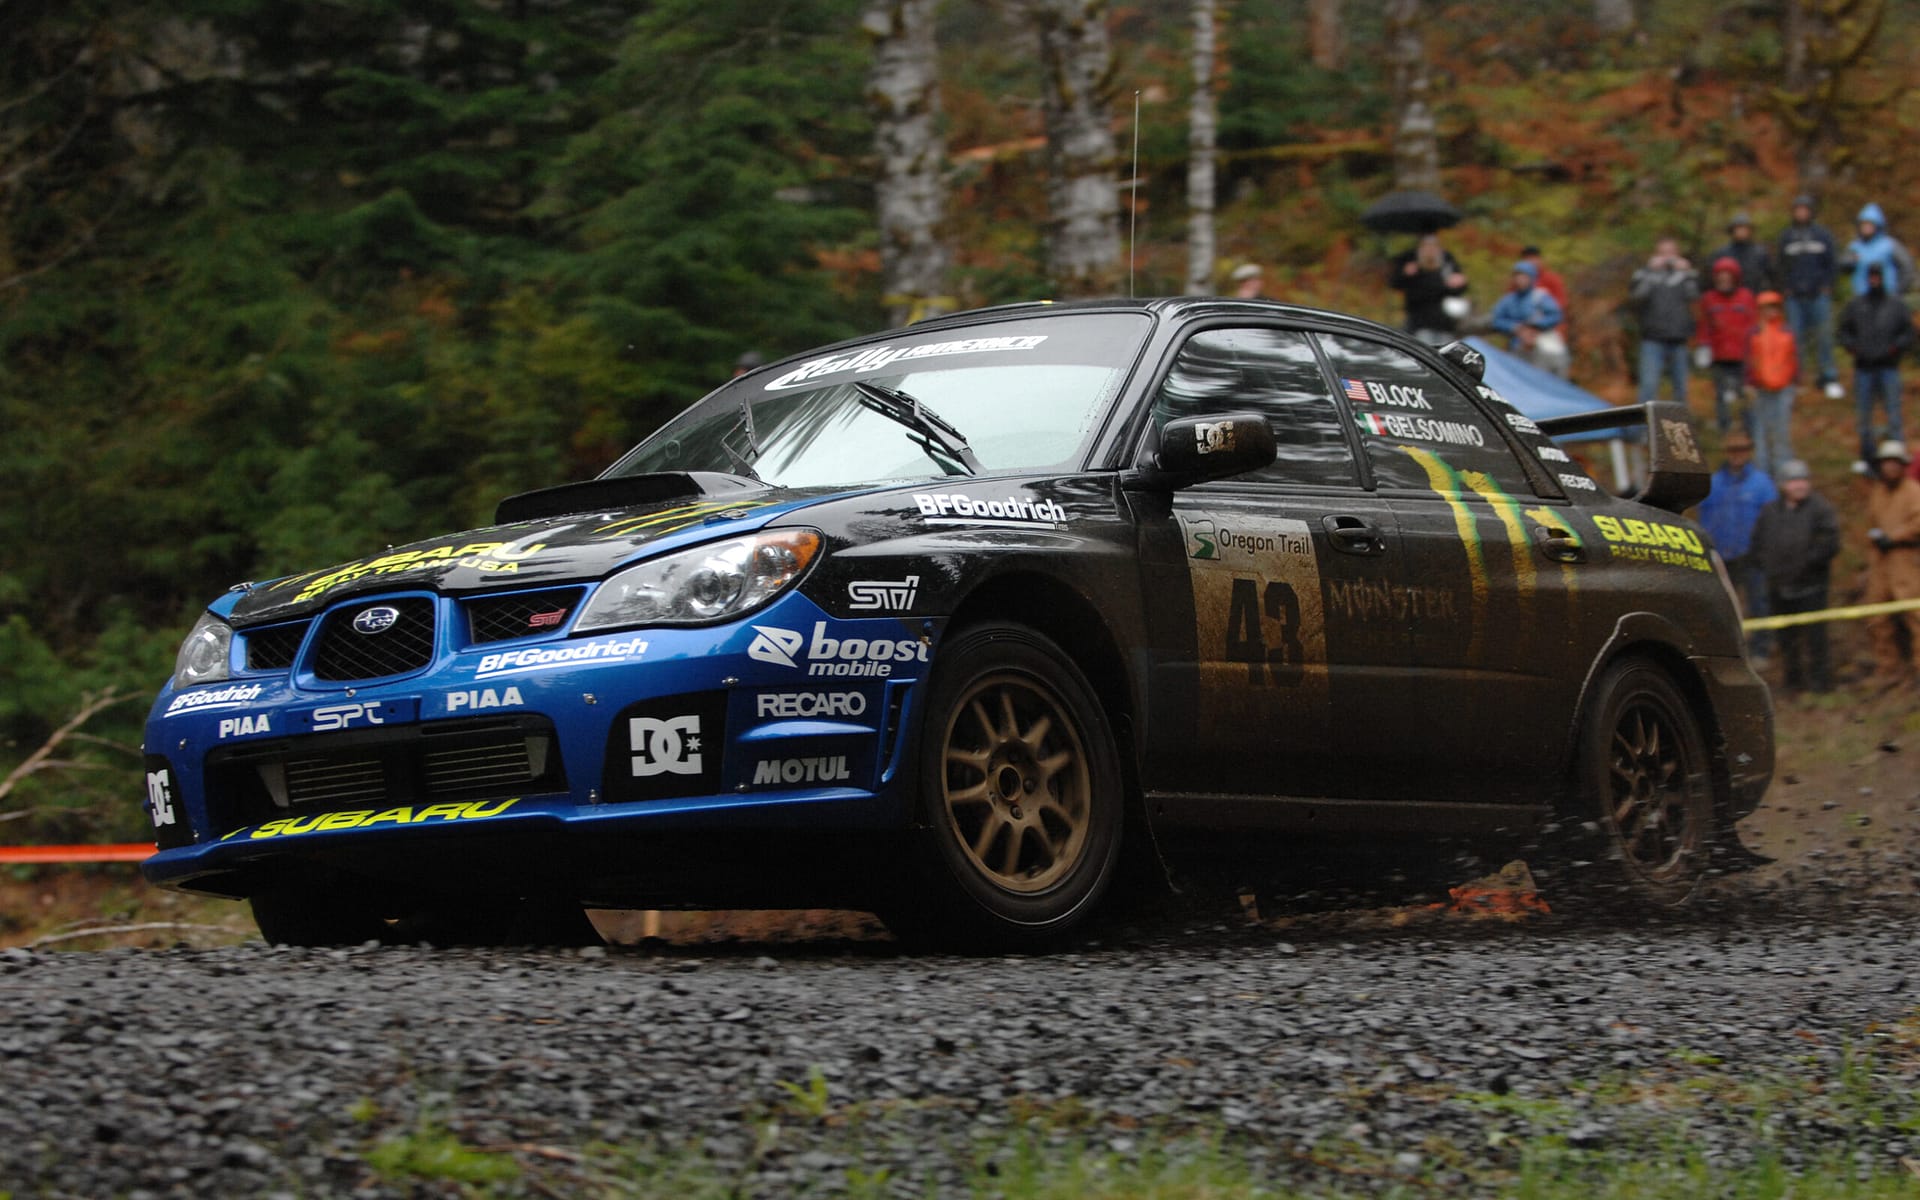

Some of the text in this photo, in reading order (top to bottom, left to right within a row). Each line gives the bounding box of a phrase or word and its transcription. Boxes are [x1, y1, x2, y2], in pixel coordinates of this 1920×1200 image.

[1367, 381, 1432, 410] BLOCK
[1385, 414, 1484, 447] GELSOMINO
[912, 494, 1067, 522] BFGoodrich
[1219, 528, 1310, 555] Oregon Trail
[1592, 515, 1704, 555] SUBARU
[303, 542, 546, 592] SUBARU
[375, 559, 454, 575] TEAM
[457, 556, 519, 573] USA
[808, 621, 930, 662] boost
[1225, 577, 1305, 688] 43
[476, 638, 649, 674] BFGoodrich
[808, 661, 892, 677] mobile
[167, 683, 263, 712] BFGoodrich
[446, 686, 525, 712] PIAA
[757, 691, 866, 718] RECARO
[219, 714, 271, 739] PIAA
[752, 755, 850, 785] MOTUL
[250, 798, 521, 840] SUBARU
